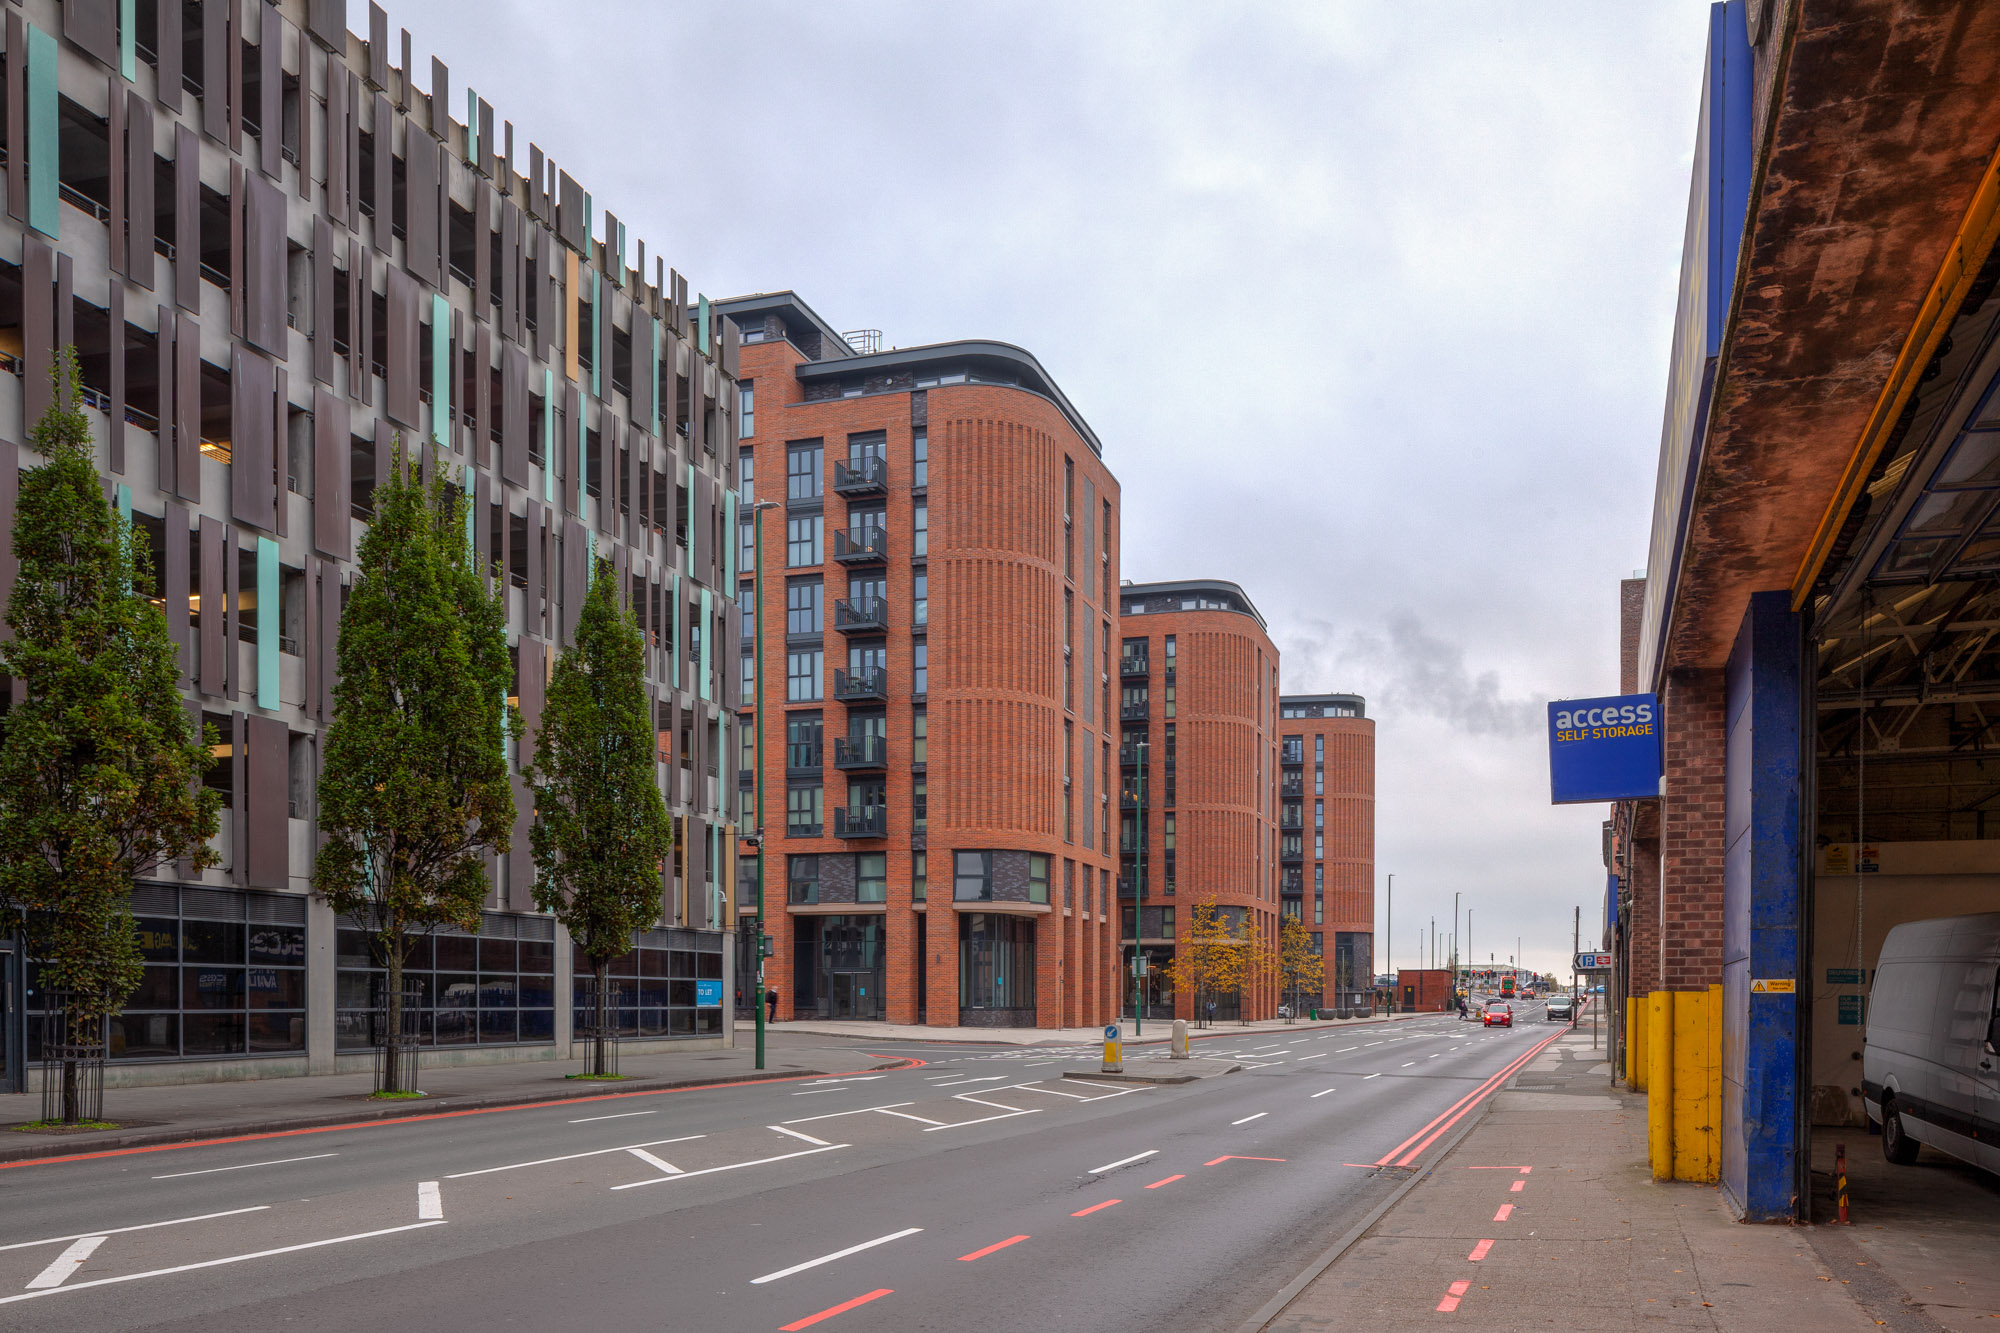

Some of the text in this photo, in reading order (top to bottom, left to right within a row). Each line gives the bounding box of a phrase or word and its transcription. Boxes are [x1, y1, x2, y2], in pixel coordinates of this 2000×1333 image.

[1555, 704, 1653, 729] access
[1557, 724, 1653, 742] SELF STORAGE
